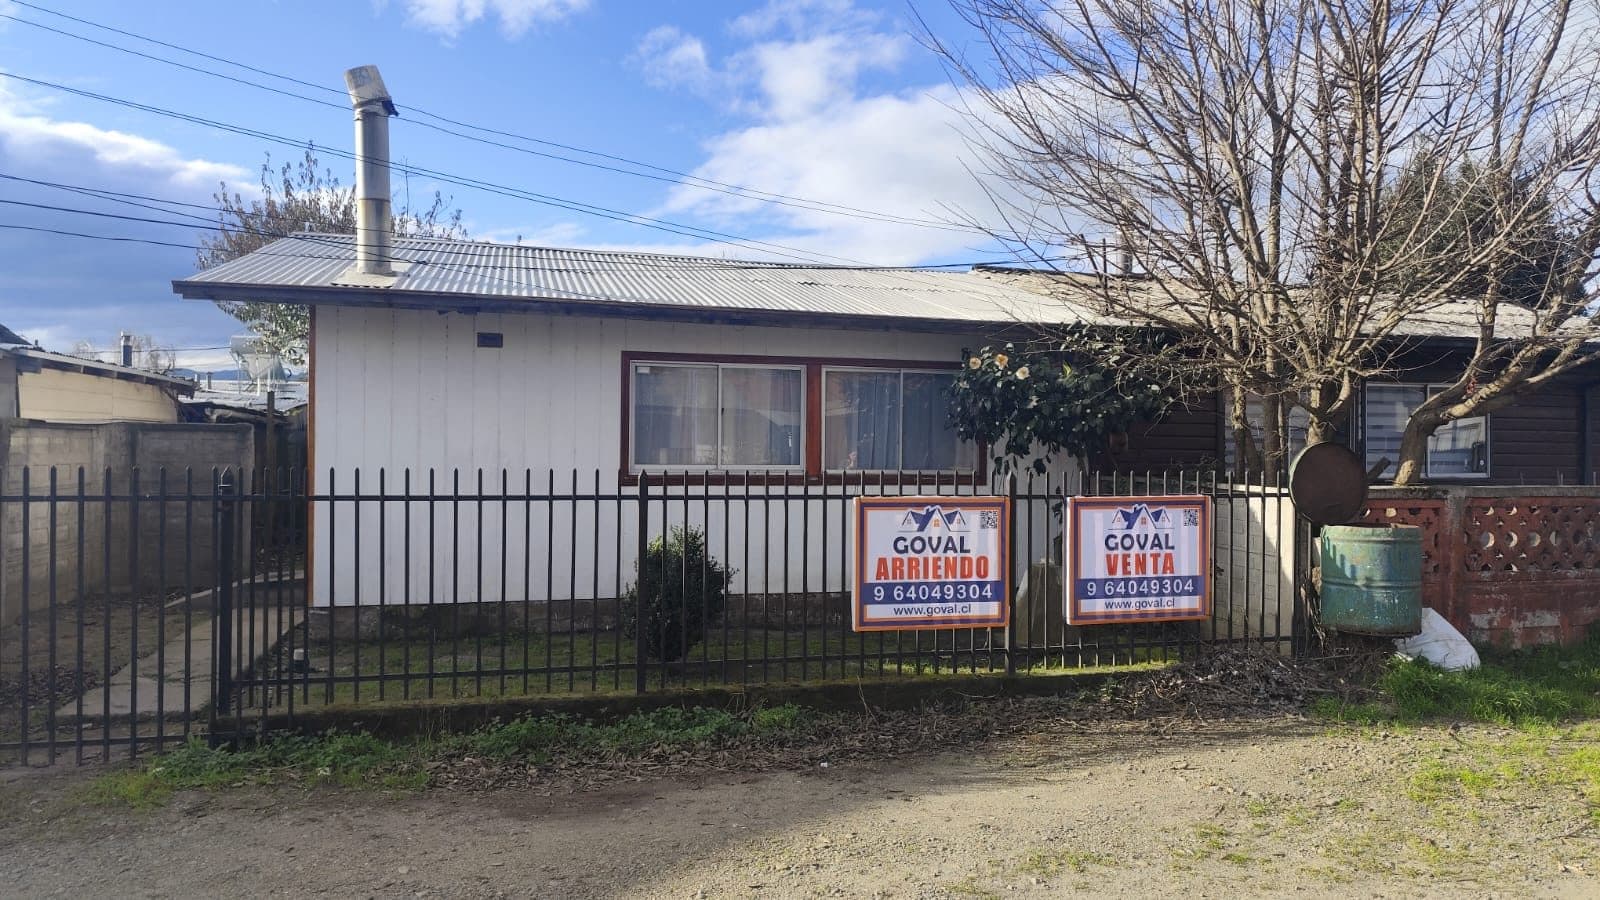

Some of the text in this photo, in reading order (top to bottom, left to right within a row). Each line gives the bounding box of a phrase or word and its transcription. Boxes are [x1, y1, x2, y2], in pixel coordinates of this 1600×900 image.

[893, 536, 971, 554] GOVAL
[1104, 533, 1175, 551] GOVAL
[875, 555, 989, 580] ARRIENDO
[1106, 553, 1175, 576] VENTA
[874, 583, 993, 601] 9 64049304
[1087, 579, 1194, 596] 9 64049304
[893, 603, 972, 616] www.goval.cl
[1104, 598, 1175, 610] www.goval.cl
